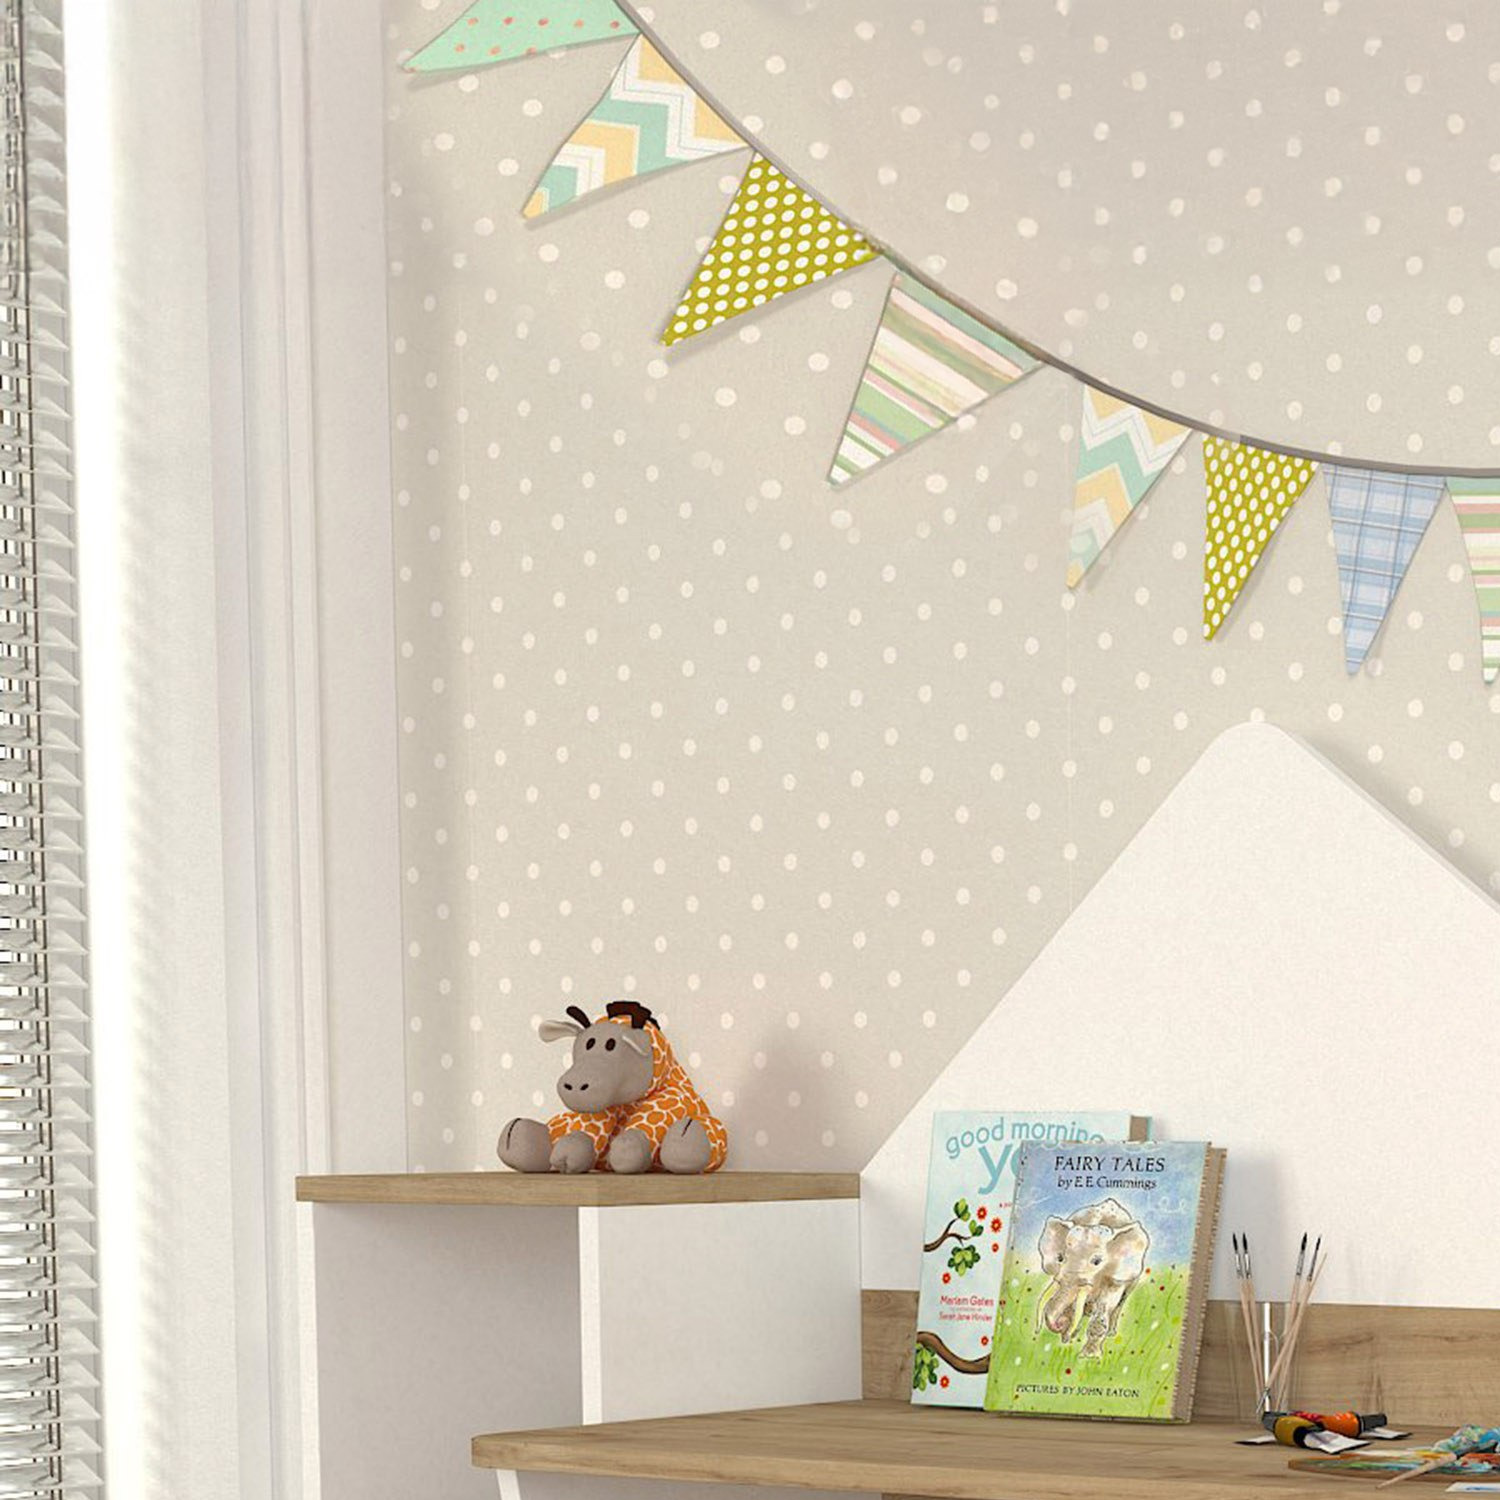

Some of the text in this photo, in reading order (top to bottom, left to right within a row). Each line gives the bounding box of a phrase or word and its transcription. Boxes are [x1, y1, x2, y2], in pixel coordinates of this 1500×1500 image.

[945, 1116, 1004, 1159] good
[1054, 1155, 1166, 1173] FAIRY TALES
[1057, 1176, 1073, 1190] by
[1096, 1175, 1157, 1190] Cummings
[1015, 1384, 1140, 1398] PICTURES BY JOHN EATON
